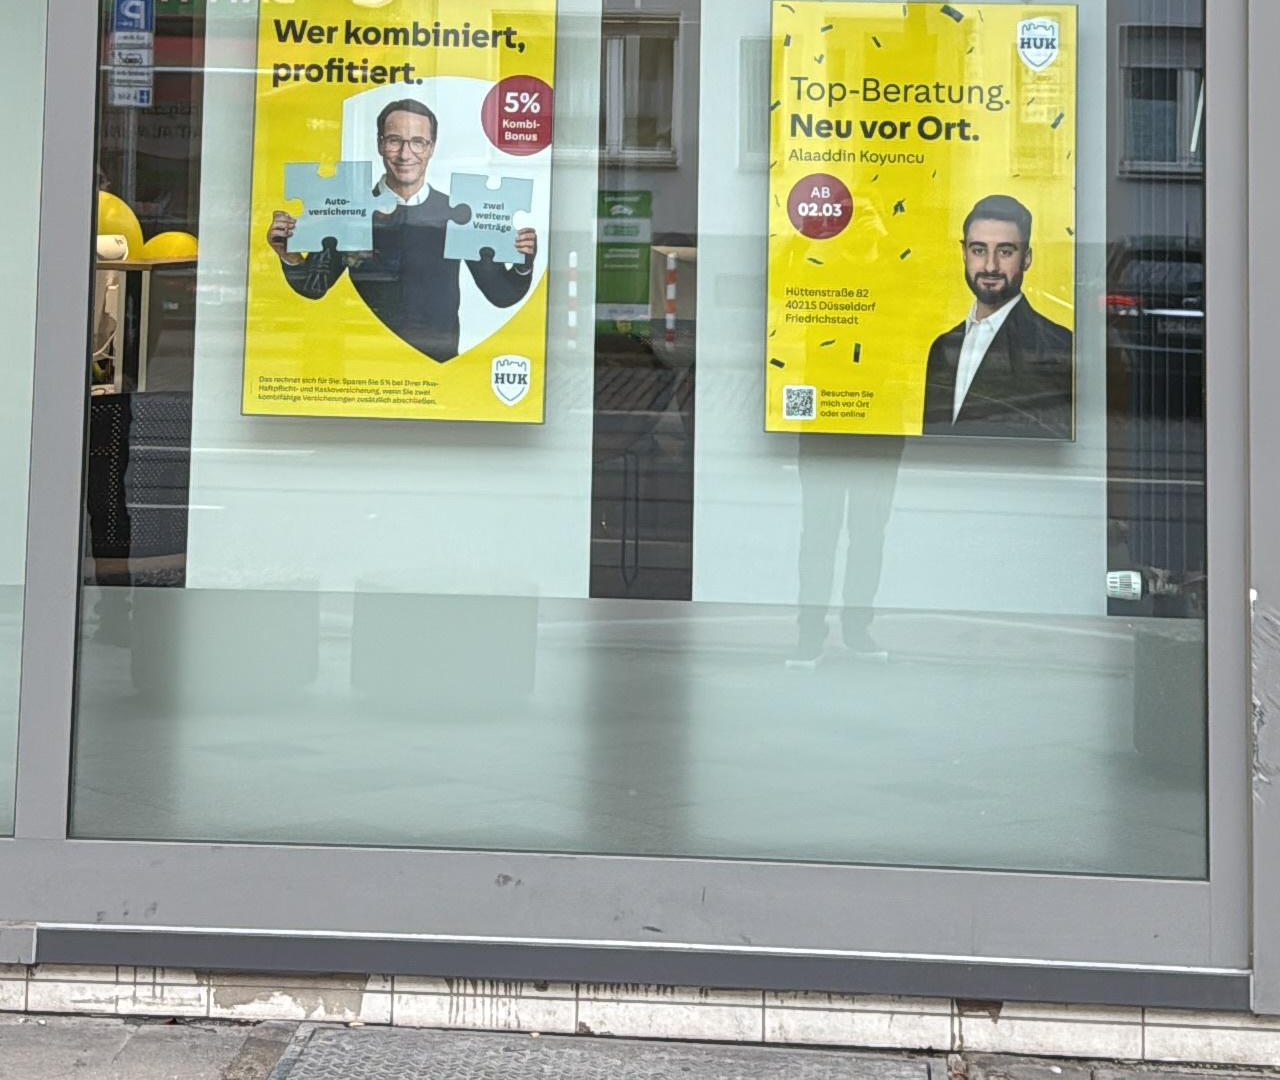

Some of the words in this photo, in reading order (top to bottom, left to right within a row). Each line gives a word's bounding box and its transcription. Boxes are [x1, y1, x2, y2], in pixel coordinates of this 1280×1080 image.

[273, 19, 338, 45] Wer
[345, 20, 526, 53] kombiniert,
[1020, 36, 1057, 51] HUK
[272, 58, 423, 87] profitiert.
[790, 76, 1011, 112] Top-Beratung.
[504, 92, 541, 114] 5%
[502, 118, 541, 130] Kombi-
[790, 114, 852, 140] Neu
[860, 119, 910, 141] vor
[917, 116, 980, 142] Ort.
[504, 131, 538, 142] Bonus
[789, 149, 856, 164] Alaaddin
[860, 150, 925, 166] Koyuncu
[810, 187, 831, 199] AB
[325, 197, 350, 206] Auto-
[483, 202, 504, 211] zwei
[308, 208, 367, 218] versicherung
[797, 202, 843, 217] 02.03
[475, 211, 510, 221] weitere
[473, 221, 512, 232] Verträge
[785, 287, 854, 298] Hüttenstraße
[785, 300, 817, 310] 40215
[819, 301, 876, 311] Düsseldorf
[785, 313, 859, 325] Friedrichstadt
[494, 372, 528, 386] HUK
